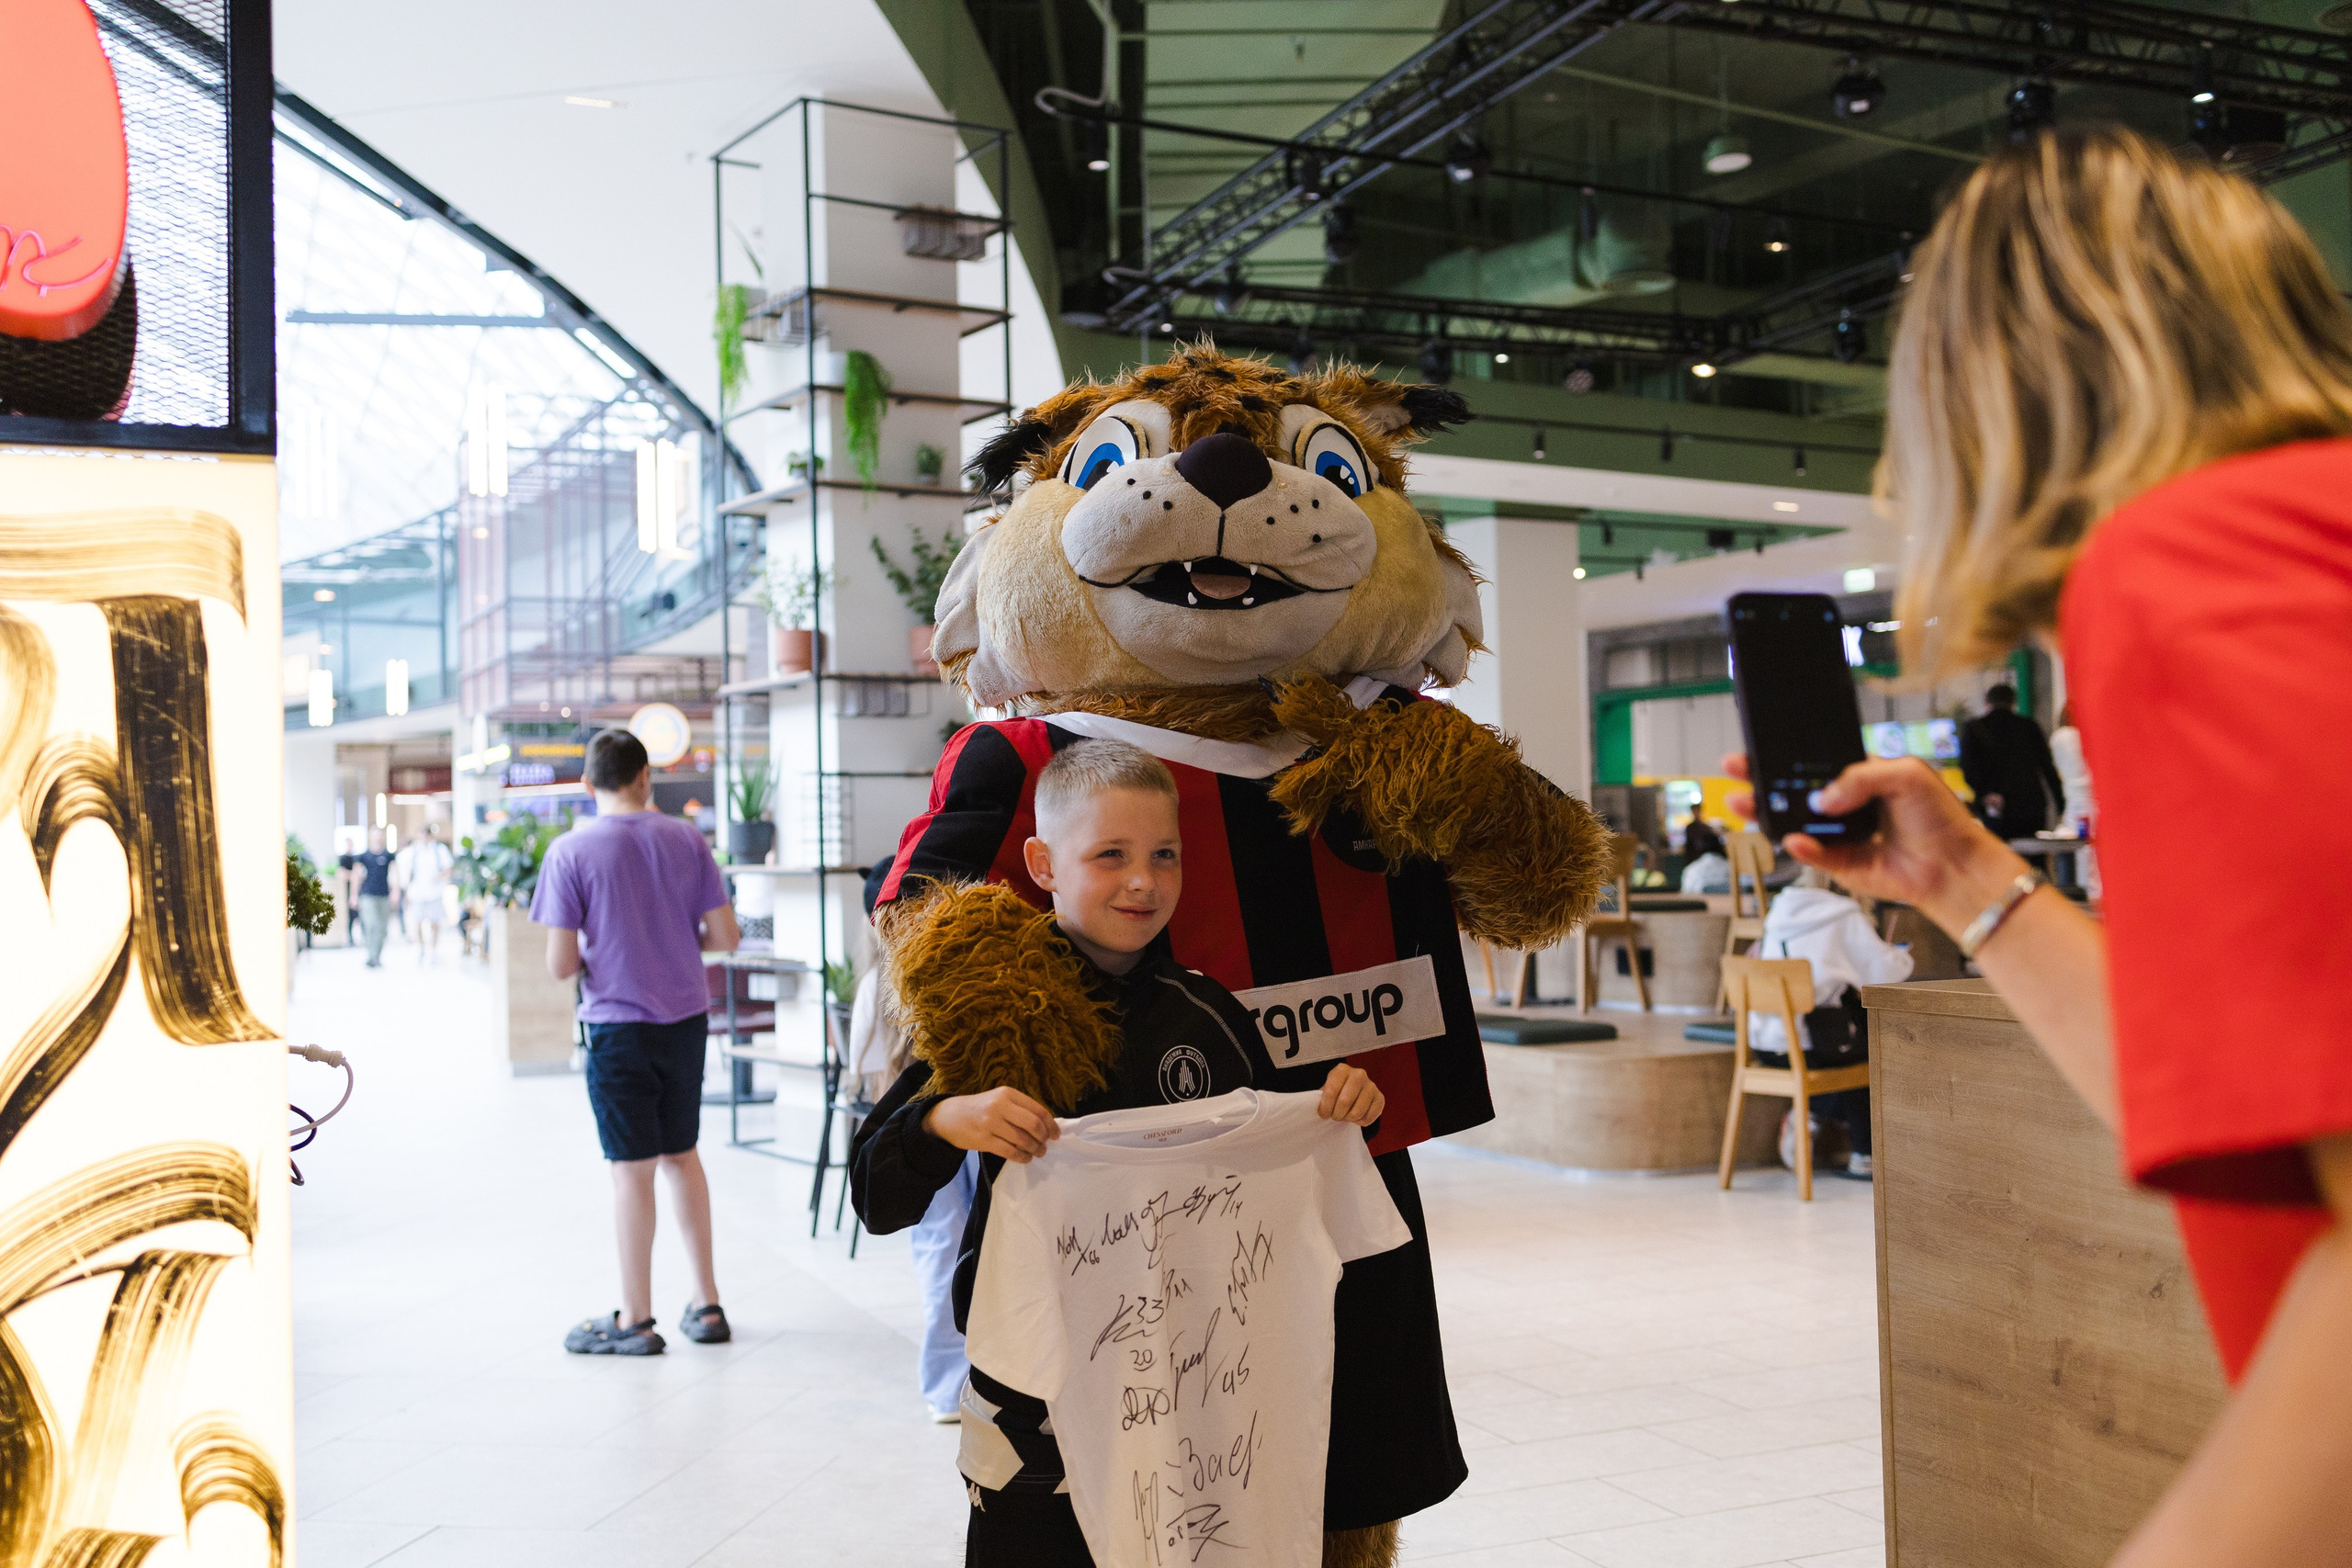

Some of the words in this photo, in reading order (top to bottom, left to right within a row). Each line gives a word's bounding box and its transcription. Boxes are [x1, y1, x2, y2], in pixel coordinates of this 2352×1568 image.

[1162, 1049, 1182, 1072] АКАДЕМИЯ
[1185, 1049, 1205, 1069] ФУТБОЛА
[1130, 1348, 1153, 1366] 20
